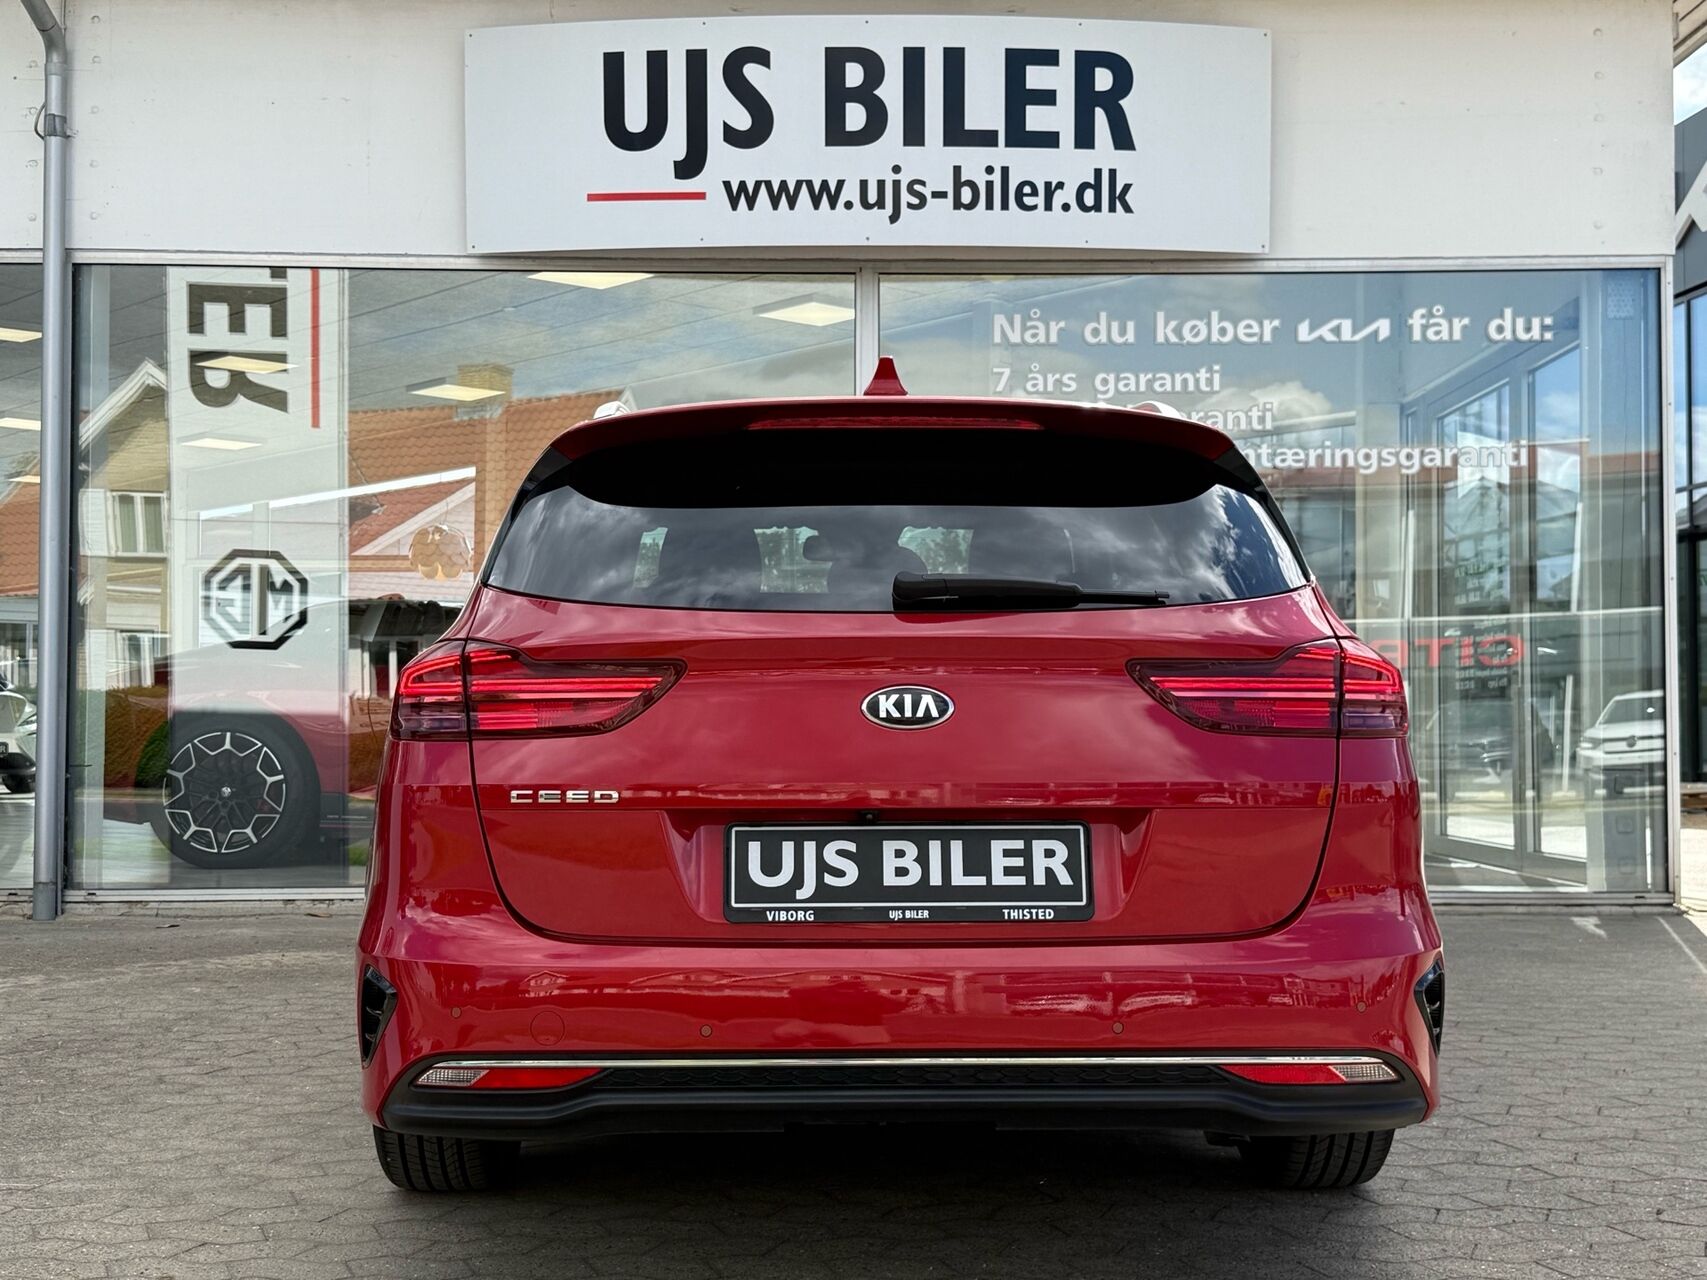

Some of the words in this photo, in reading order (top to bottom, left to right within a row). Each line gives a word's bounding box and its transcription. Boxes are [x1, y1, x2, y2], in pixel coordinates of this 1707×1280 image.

[603, 46, 774, 180] UJS
[824, 46, 1136, 151] BILER
[722, 164, 1134, 225] www.ujs-biler.dk
[993, 309, 1065, 344] Når
[1083, 312, 1136, 344] du
[1155, 310, 1281, 345] køber
[1407, 305, 1470, 342] får
[1487, 307, 1554, 342] du:
[992, 367, 1011, 392] 7
[1025, 363, 1078, 393] års
[1093, 364, 1222, 399] garanti
[877, 693, 940, 718] KIA
[510, 790, 619, 803] CEED
[747, 840, 859, 900] UJS
[882, 839, 1074, 886] BILER
[766, 910, 815, 922] VIBORG
[889, 910, 904, 920] UJS
[905, 909, 930, 919] BILER
[1002, 908, 1055, 920] THISTED
